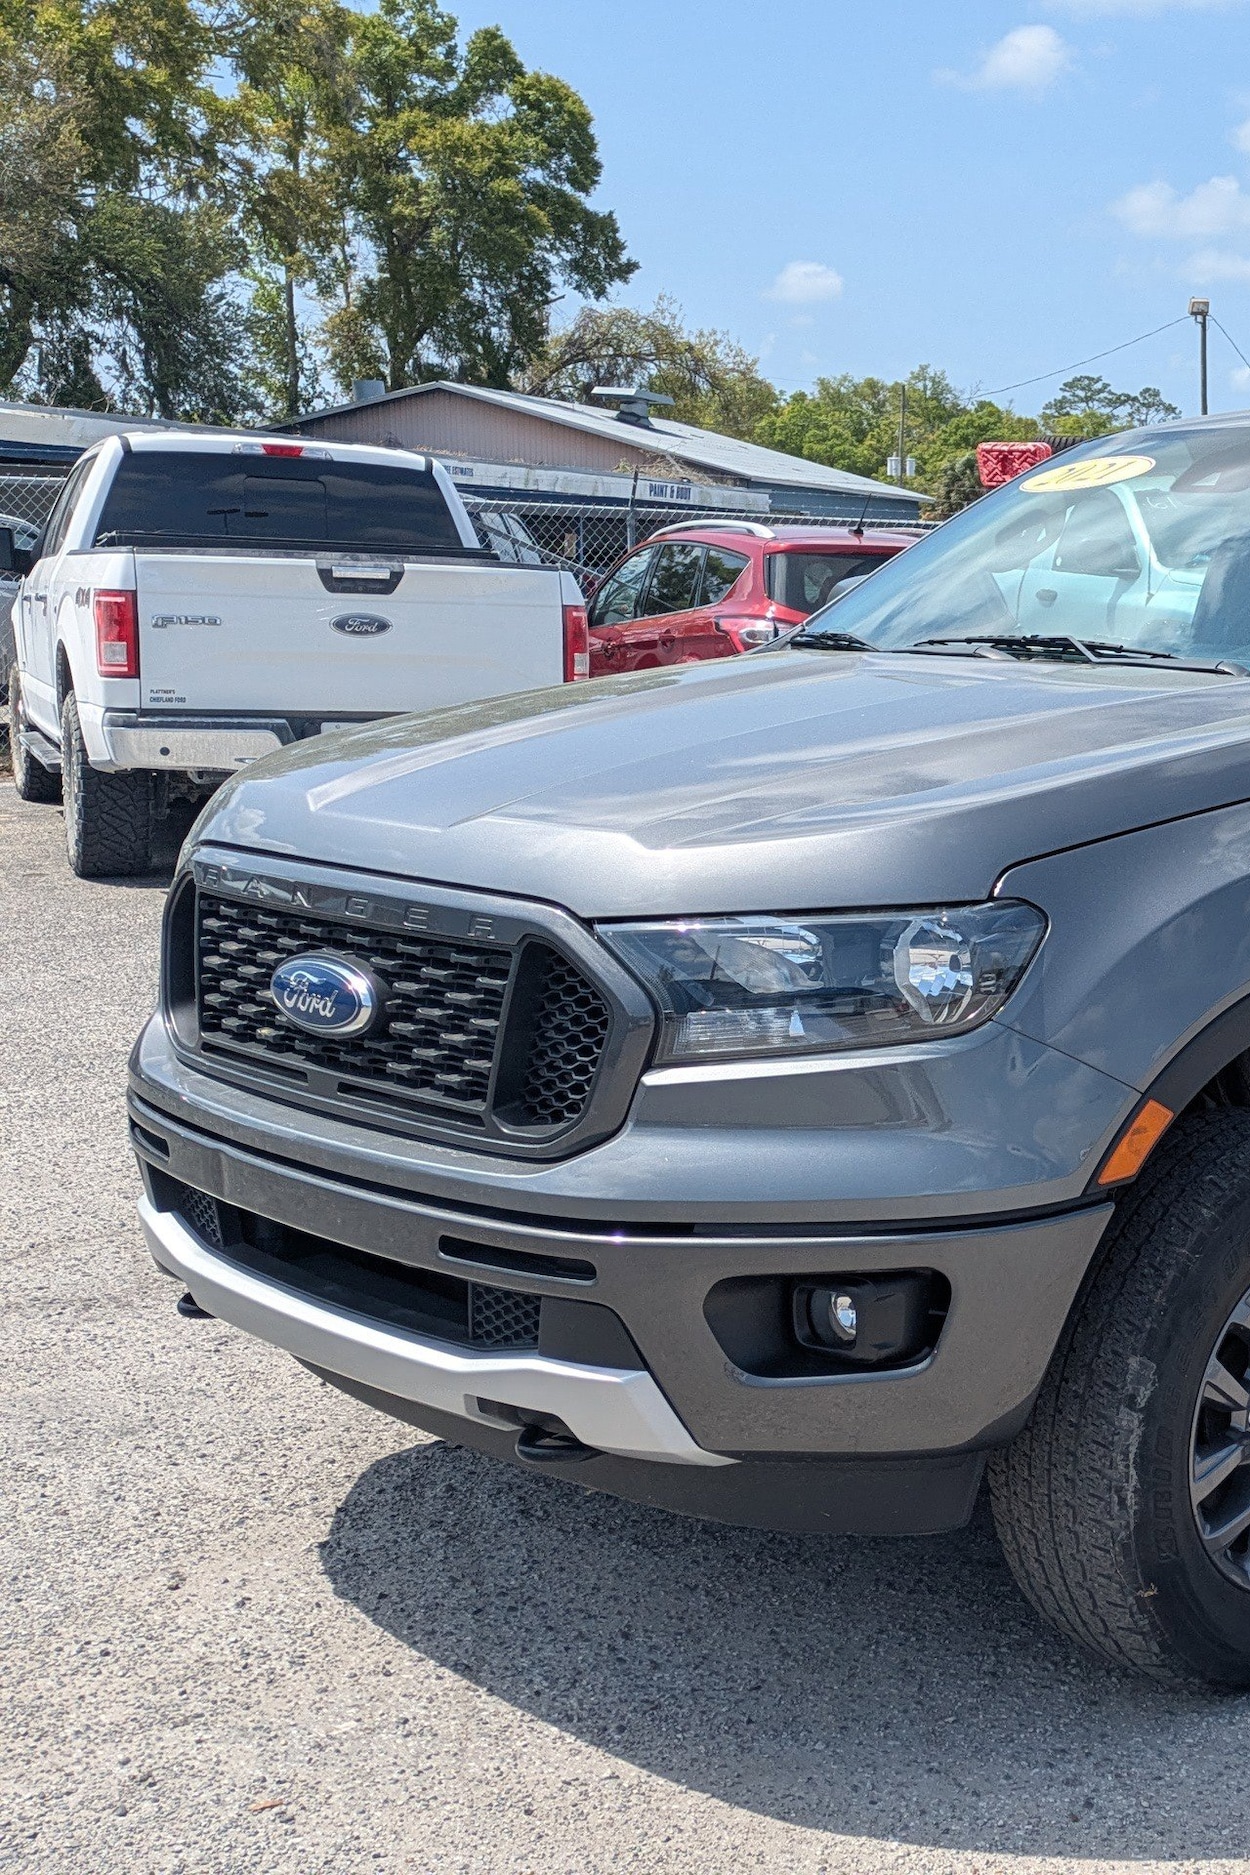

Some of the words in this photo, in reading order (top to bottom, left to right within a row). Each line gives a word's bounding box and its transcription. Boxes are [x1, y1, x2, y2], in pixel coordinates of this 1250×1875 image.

[1032, 459, 1139, 487] 2021
[649, 483, 668, 498] PAINT
[345, 618, 379, 632] Ford
[202, 867, 496, 939] RANGER
[281, 971, 340, 1018] Ford
